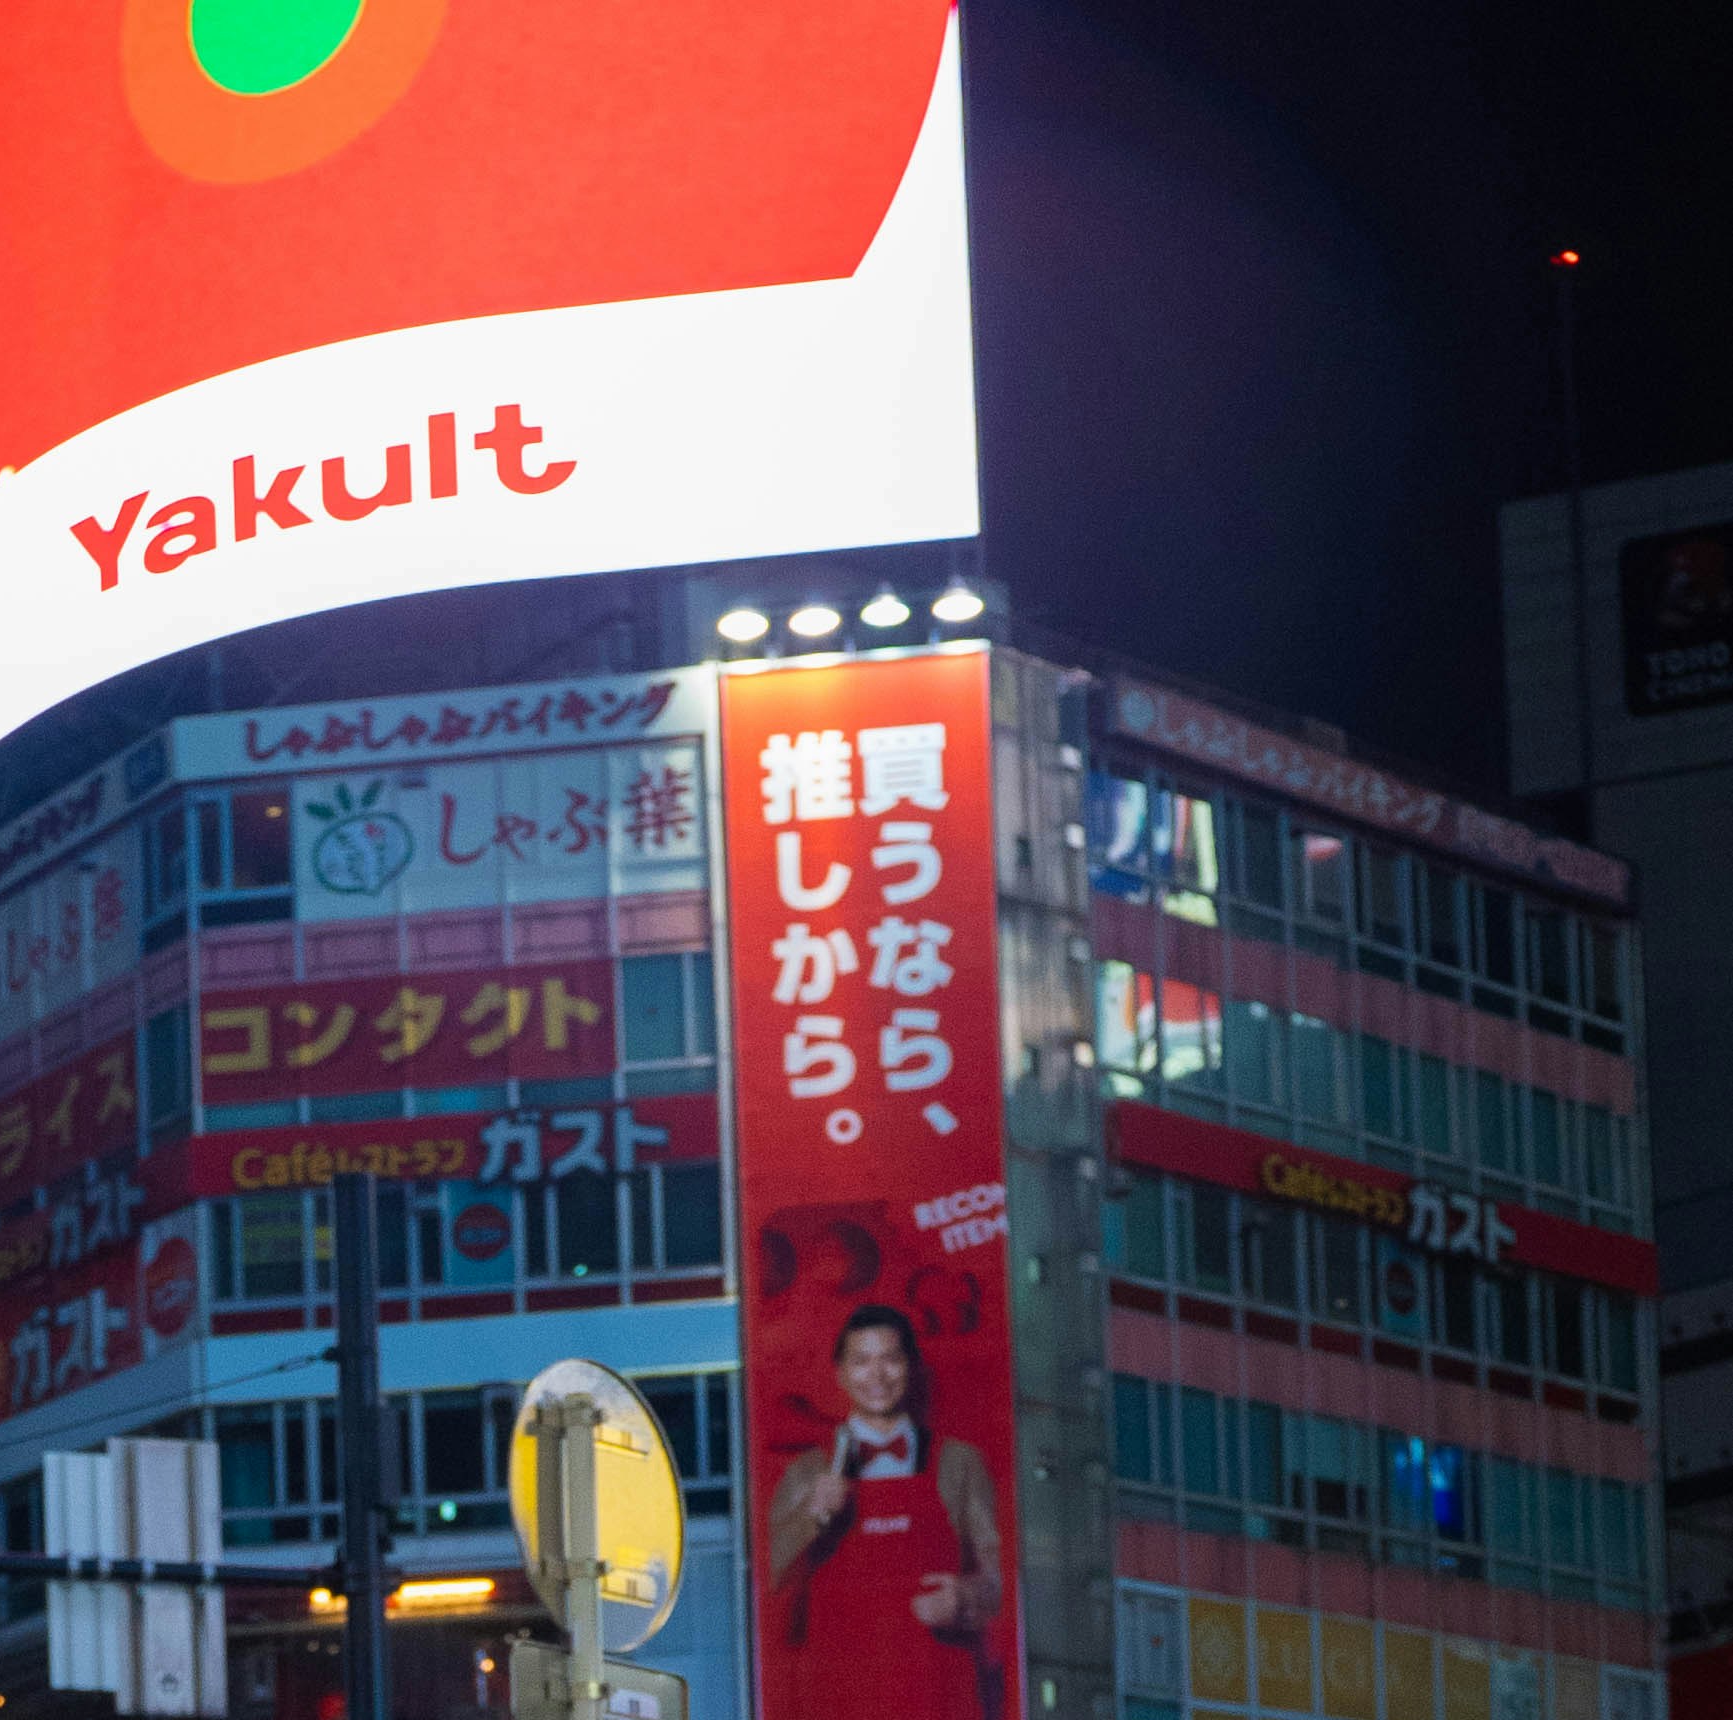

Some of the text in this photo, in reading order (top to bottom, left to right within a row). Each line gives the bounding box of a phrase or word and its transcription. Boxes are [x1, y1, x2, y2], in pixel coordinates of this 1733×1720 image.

[69, 403, 578, 592] Yakult
[245, 680, 679, 762] しゃぶしゃぶバイキング
[439, 767, 695, 866] しゃぶ葉
[759, 731, 865, 1146] 推しから。
[858, 721, 959, 1136] 買うなら、
[203, 977, 601, 1076] コンタクト
[478, 1107, 671, 1184] ガスト
[1408, 1183, 1518, 1264] ガスト
